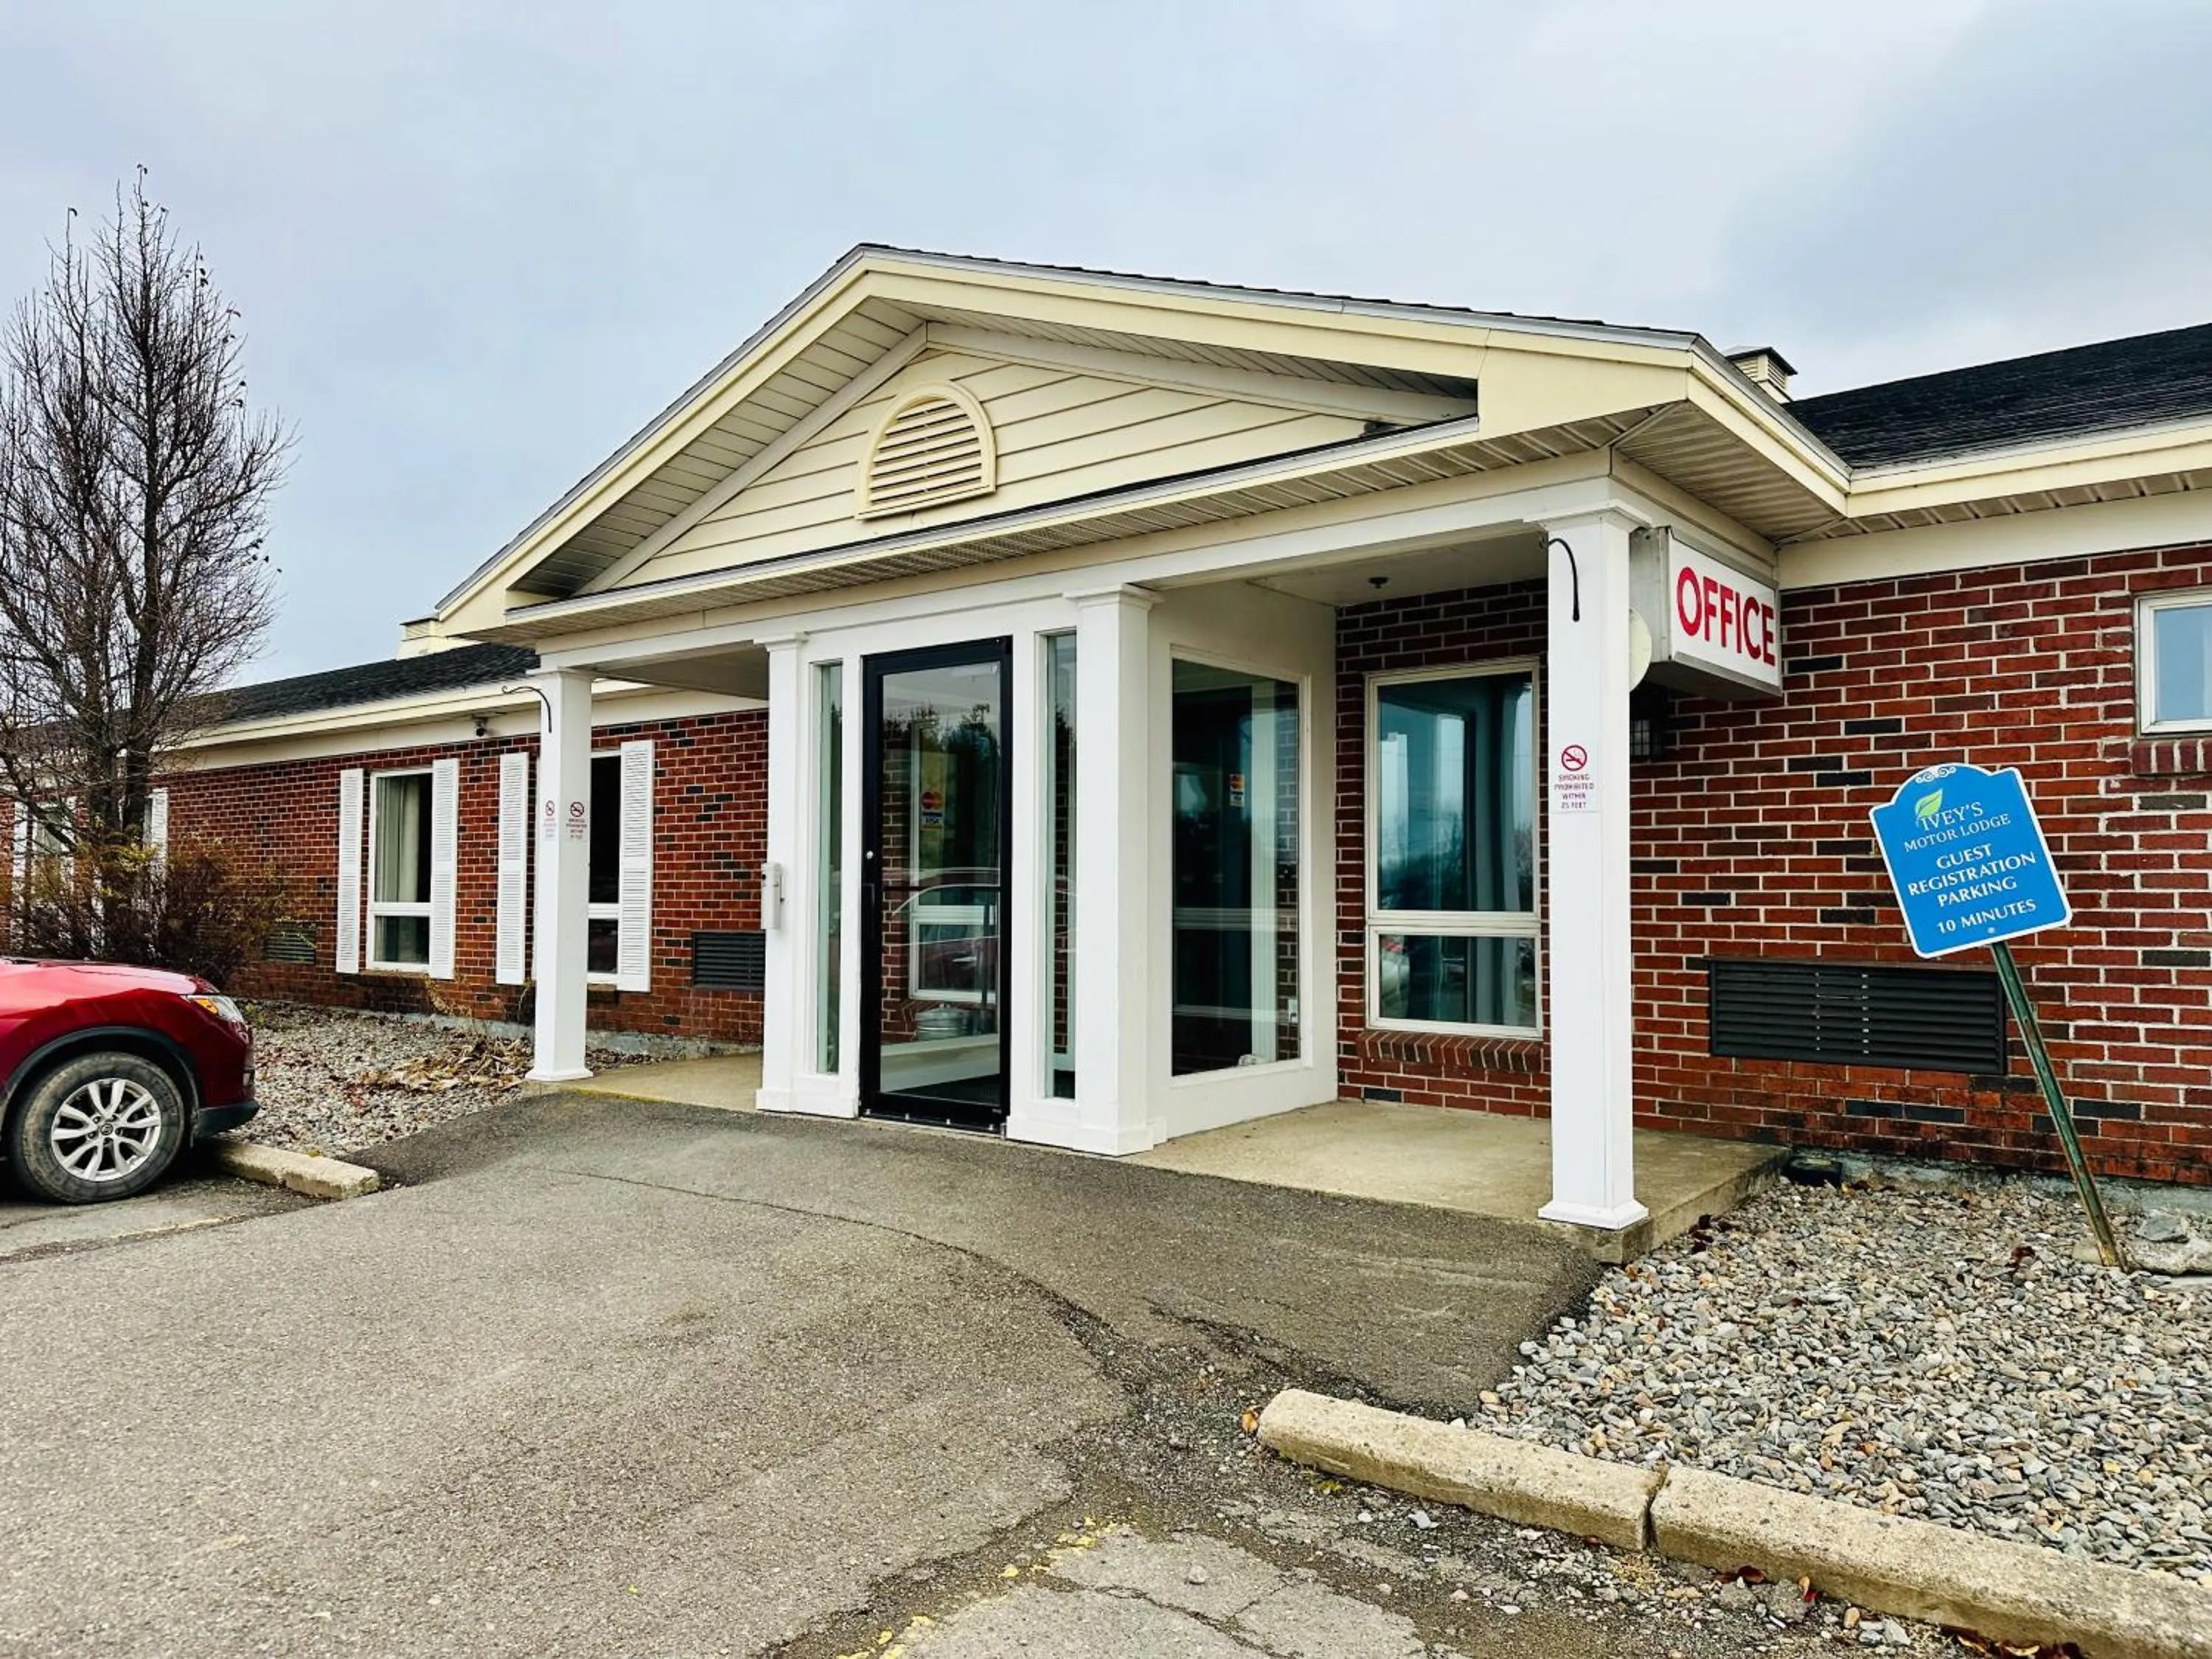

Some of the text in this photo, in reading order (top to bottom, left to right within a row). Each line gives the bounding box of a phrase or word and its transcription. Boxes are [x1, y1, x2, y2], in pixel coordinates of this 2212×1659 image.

[1677, 566, 1775, 667] OFFICE
[1904, 813, 2011, 852] MOTOR LODGE
[1921, 801, 1983, 831] IVEY'S
[1936, 844, 1992, 869] GUEST
[1907, 851, 2037, 897] REGISTRATION
[1938, 876, 2017, 908] PARKING
[1938, 899, 2037, 933] 10 MINUTES
